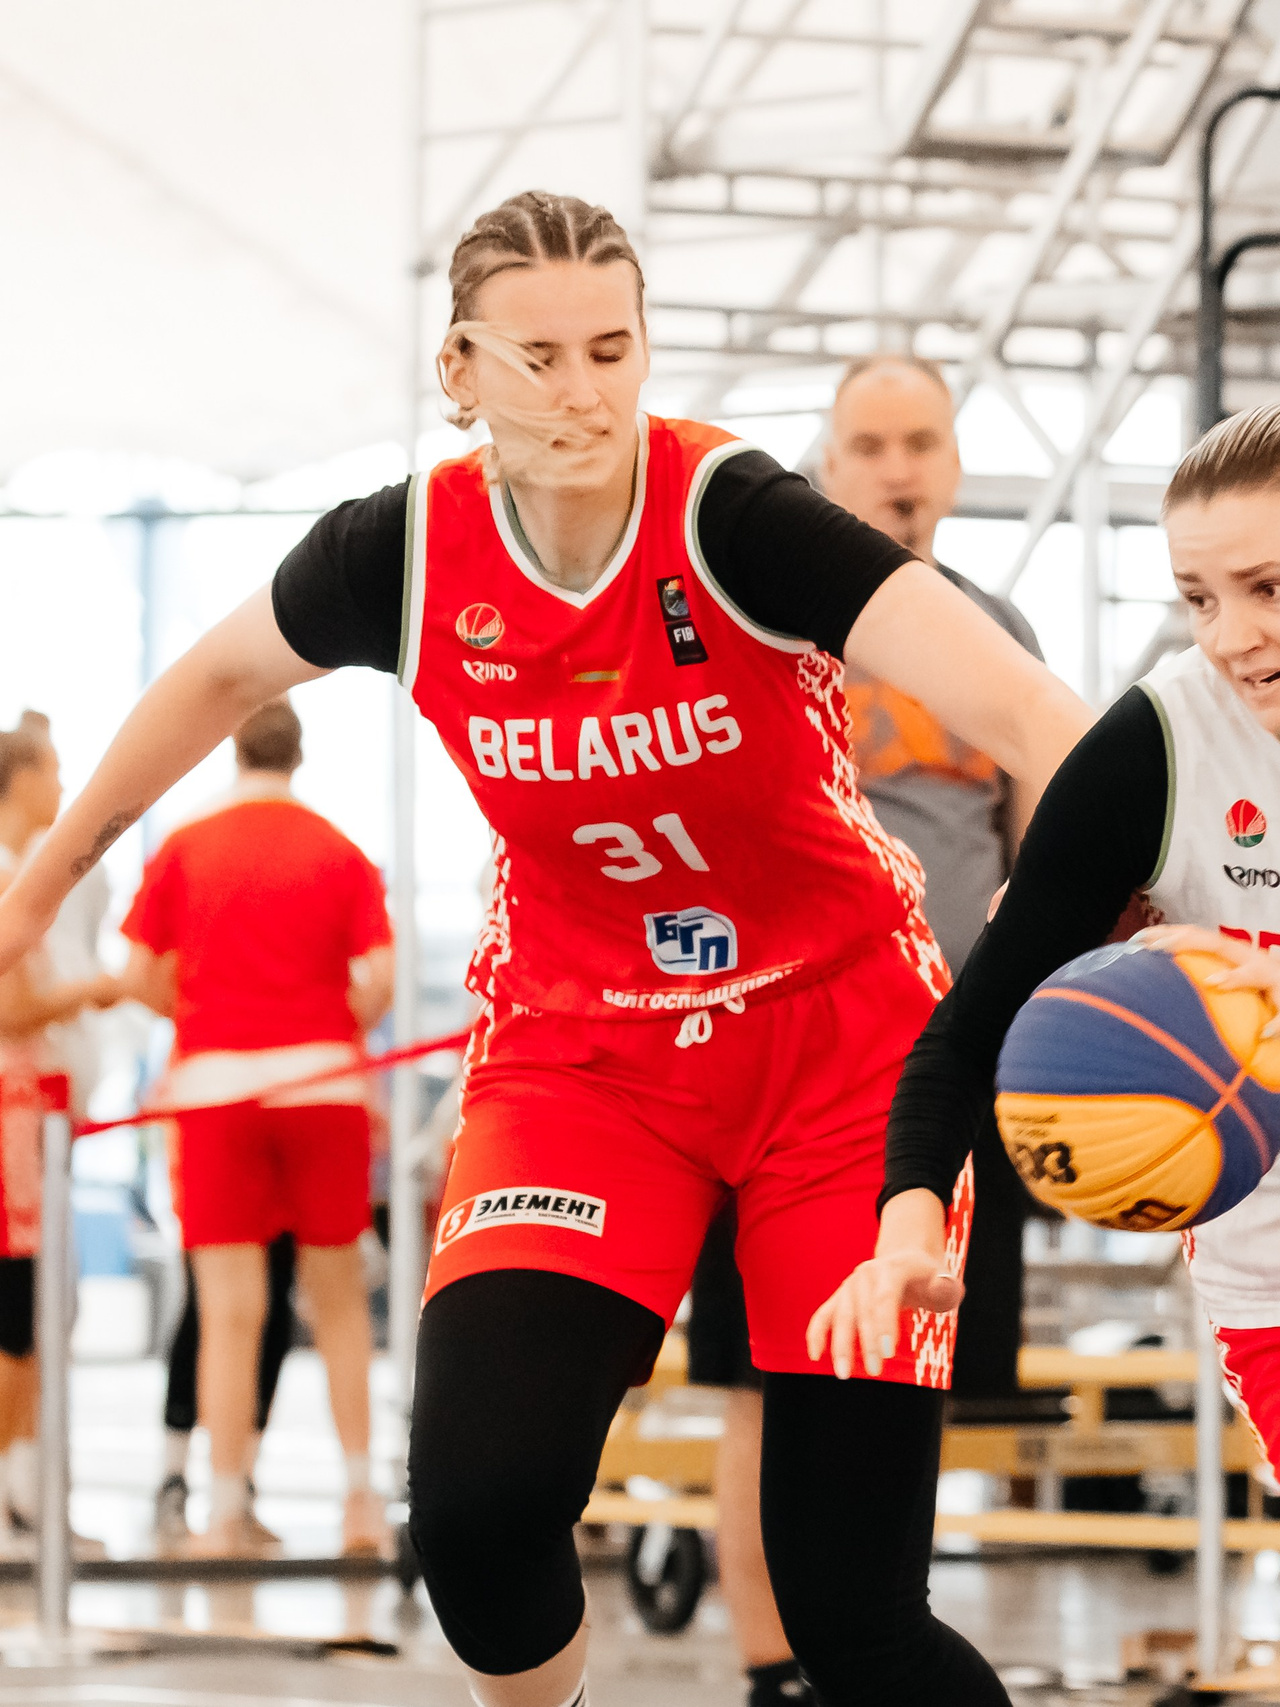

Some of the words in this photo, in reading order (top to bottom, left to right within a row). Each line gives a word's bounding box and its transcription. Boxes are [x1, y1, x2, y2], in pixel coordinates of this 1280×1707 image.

[468, 694, 743, 782] BELARUS
[572, 812, 711, 883] 31
[652, 913, 730, 971] БГП
[475, 1194, 601, 1220] ЭЛЕМЕНТ
